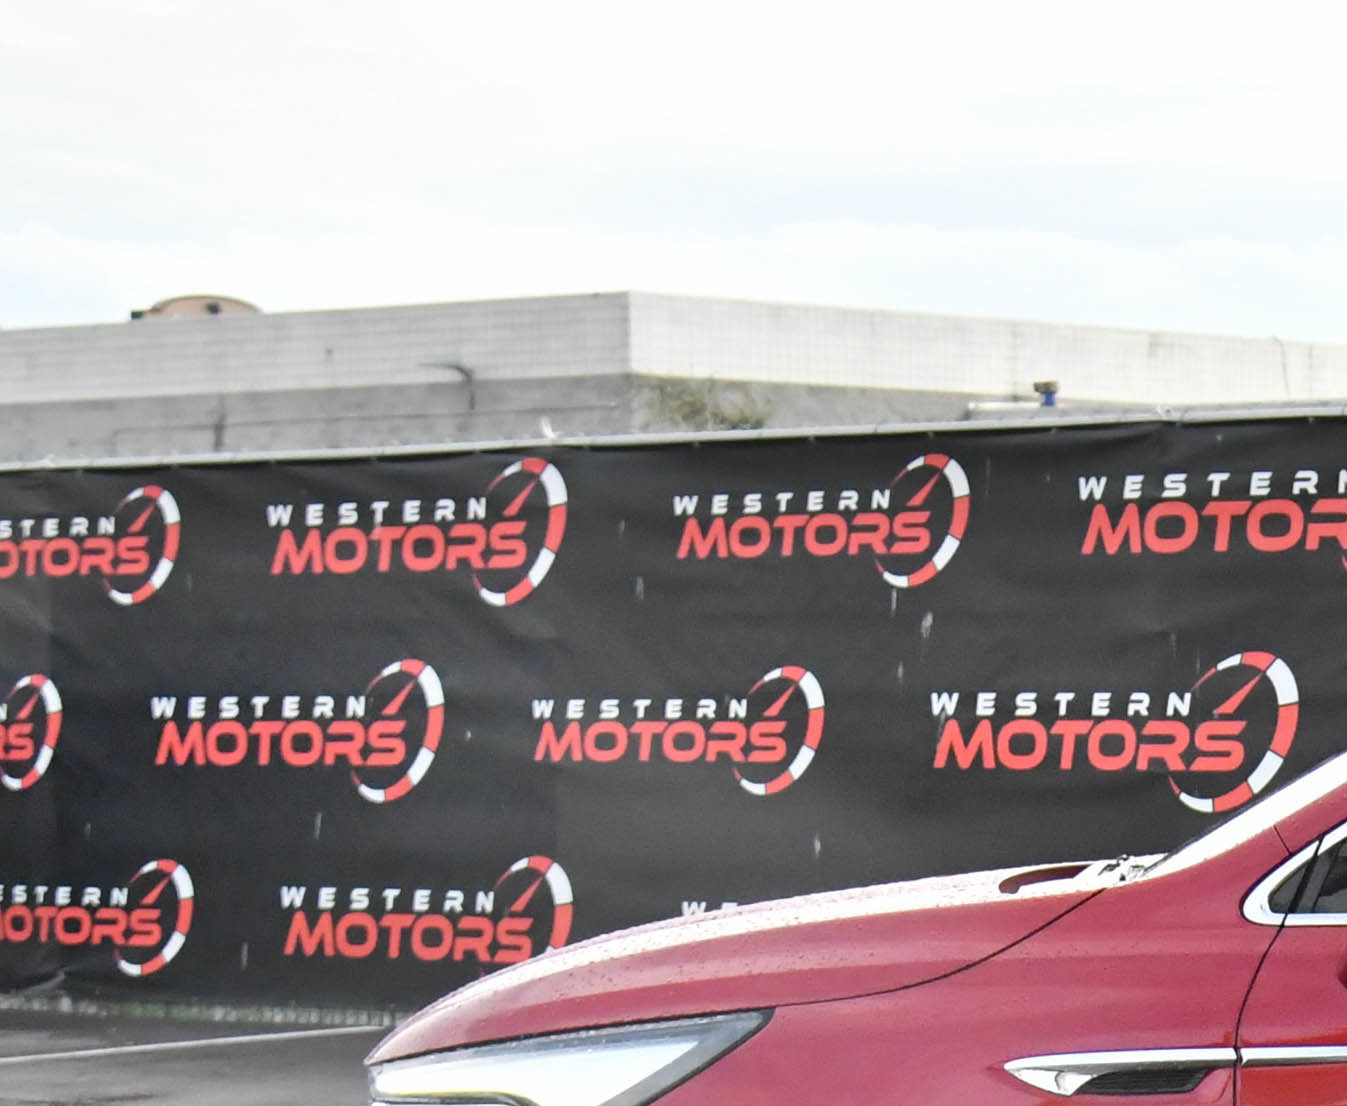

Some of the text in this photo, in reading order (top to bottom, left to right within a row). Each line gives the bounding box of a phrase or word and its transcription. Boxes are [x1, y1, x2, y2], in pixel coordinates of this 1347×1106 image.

[267, 497, 488, 527] WESTERN
[673, 488, 892, 516] WESTERN
[271, 520, 529, 575] MOTORS
[676, 510, 933, 560] MOTORS
[151, 695, 366, 719] WESTERN
[531, 698, 748, 721] WESTERN
[931, 691, 1192, 717] WESTERN
[155, 719, 407, 767] MOTORS
[535, 720, 788, 764] MOTORS
[932, 718, 1247, 773] MOTORS
[0, 884, 130, 907] STERN
[280, 886, 496, 914] WESTERN
[0, 904, 163, 948] OTORS
[284, 910, 534, 965] MOTORS
